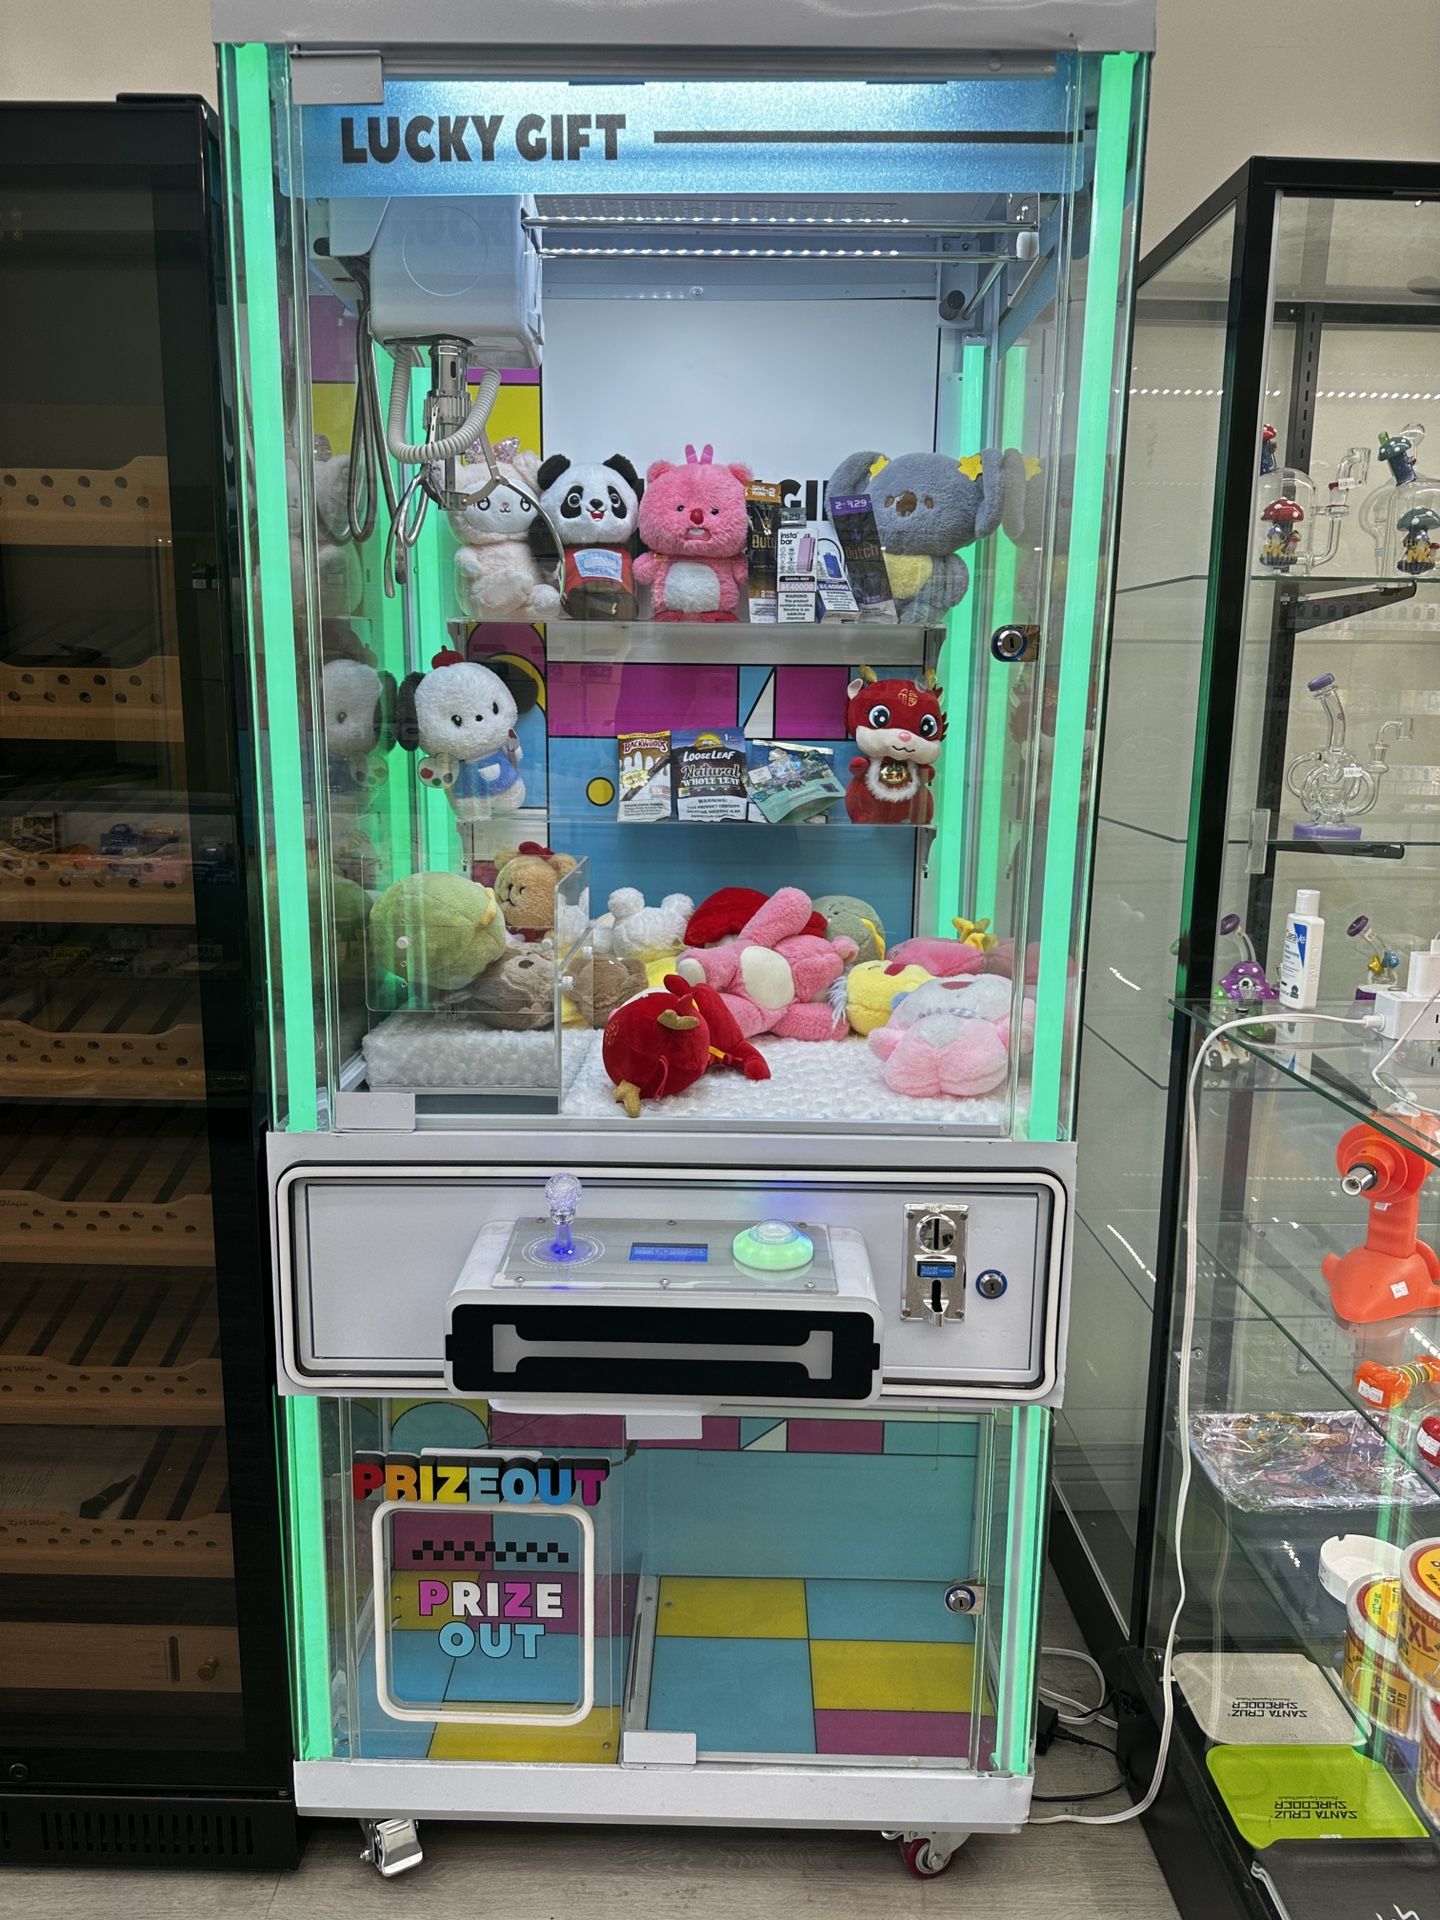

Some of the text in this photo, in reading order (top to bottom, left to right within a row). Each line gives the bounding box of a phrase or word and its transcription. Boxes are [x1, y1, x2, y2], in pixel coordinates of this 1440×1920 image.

[341, 113, 626, 164] LUCKY GIFT
[623, 739, 668, 754] BACKWOODS
[681, 762, 740, 779] Natural
[681, 777, 716, 786] WHOLE
[352, 1451, 610, 1506] PRIZEOUT
[418, 1580, 564, 1618] PRIZE
[438, 1621, 545, 1659] OUT
[1408, 1616, 1436, 1654] XL
[1231, 1709, 1308, 1718] SANTA CRUZ
[1232, 1701, 1298, 1710] SHREDDER
[1274, 1801, 1347, 1810] SHREDDER
[1274, 1810, 1358, 1819] SANTA CRUZ
